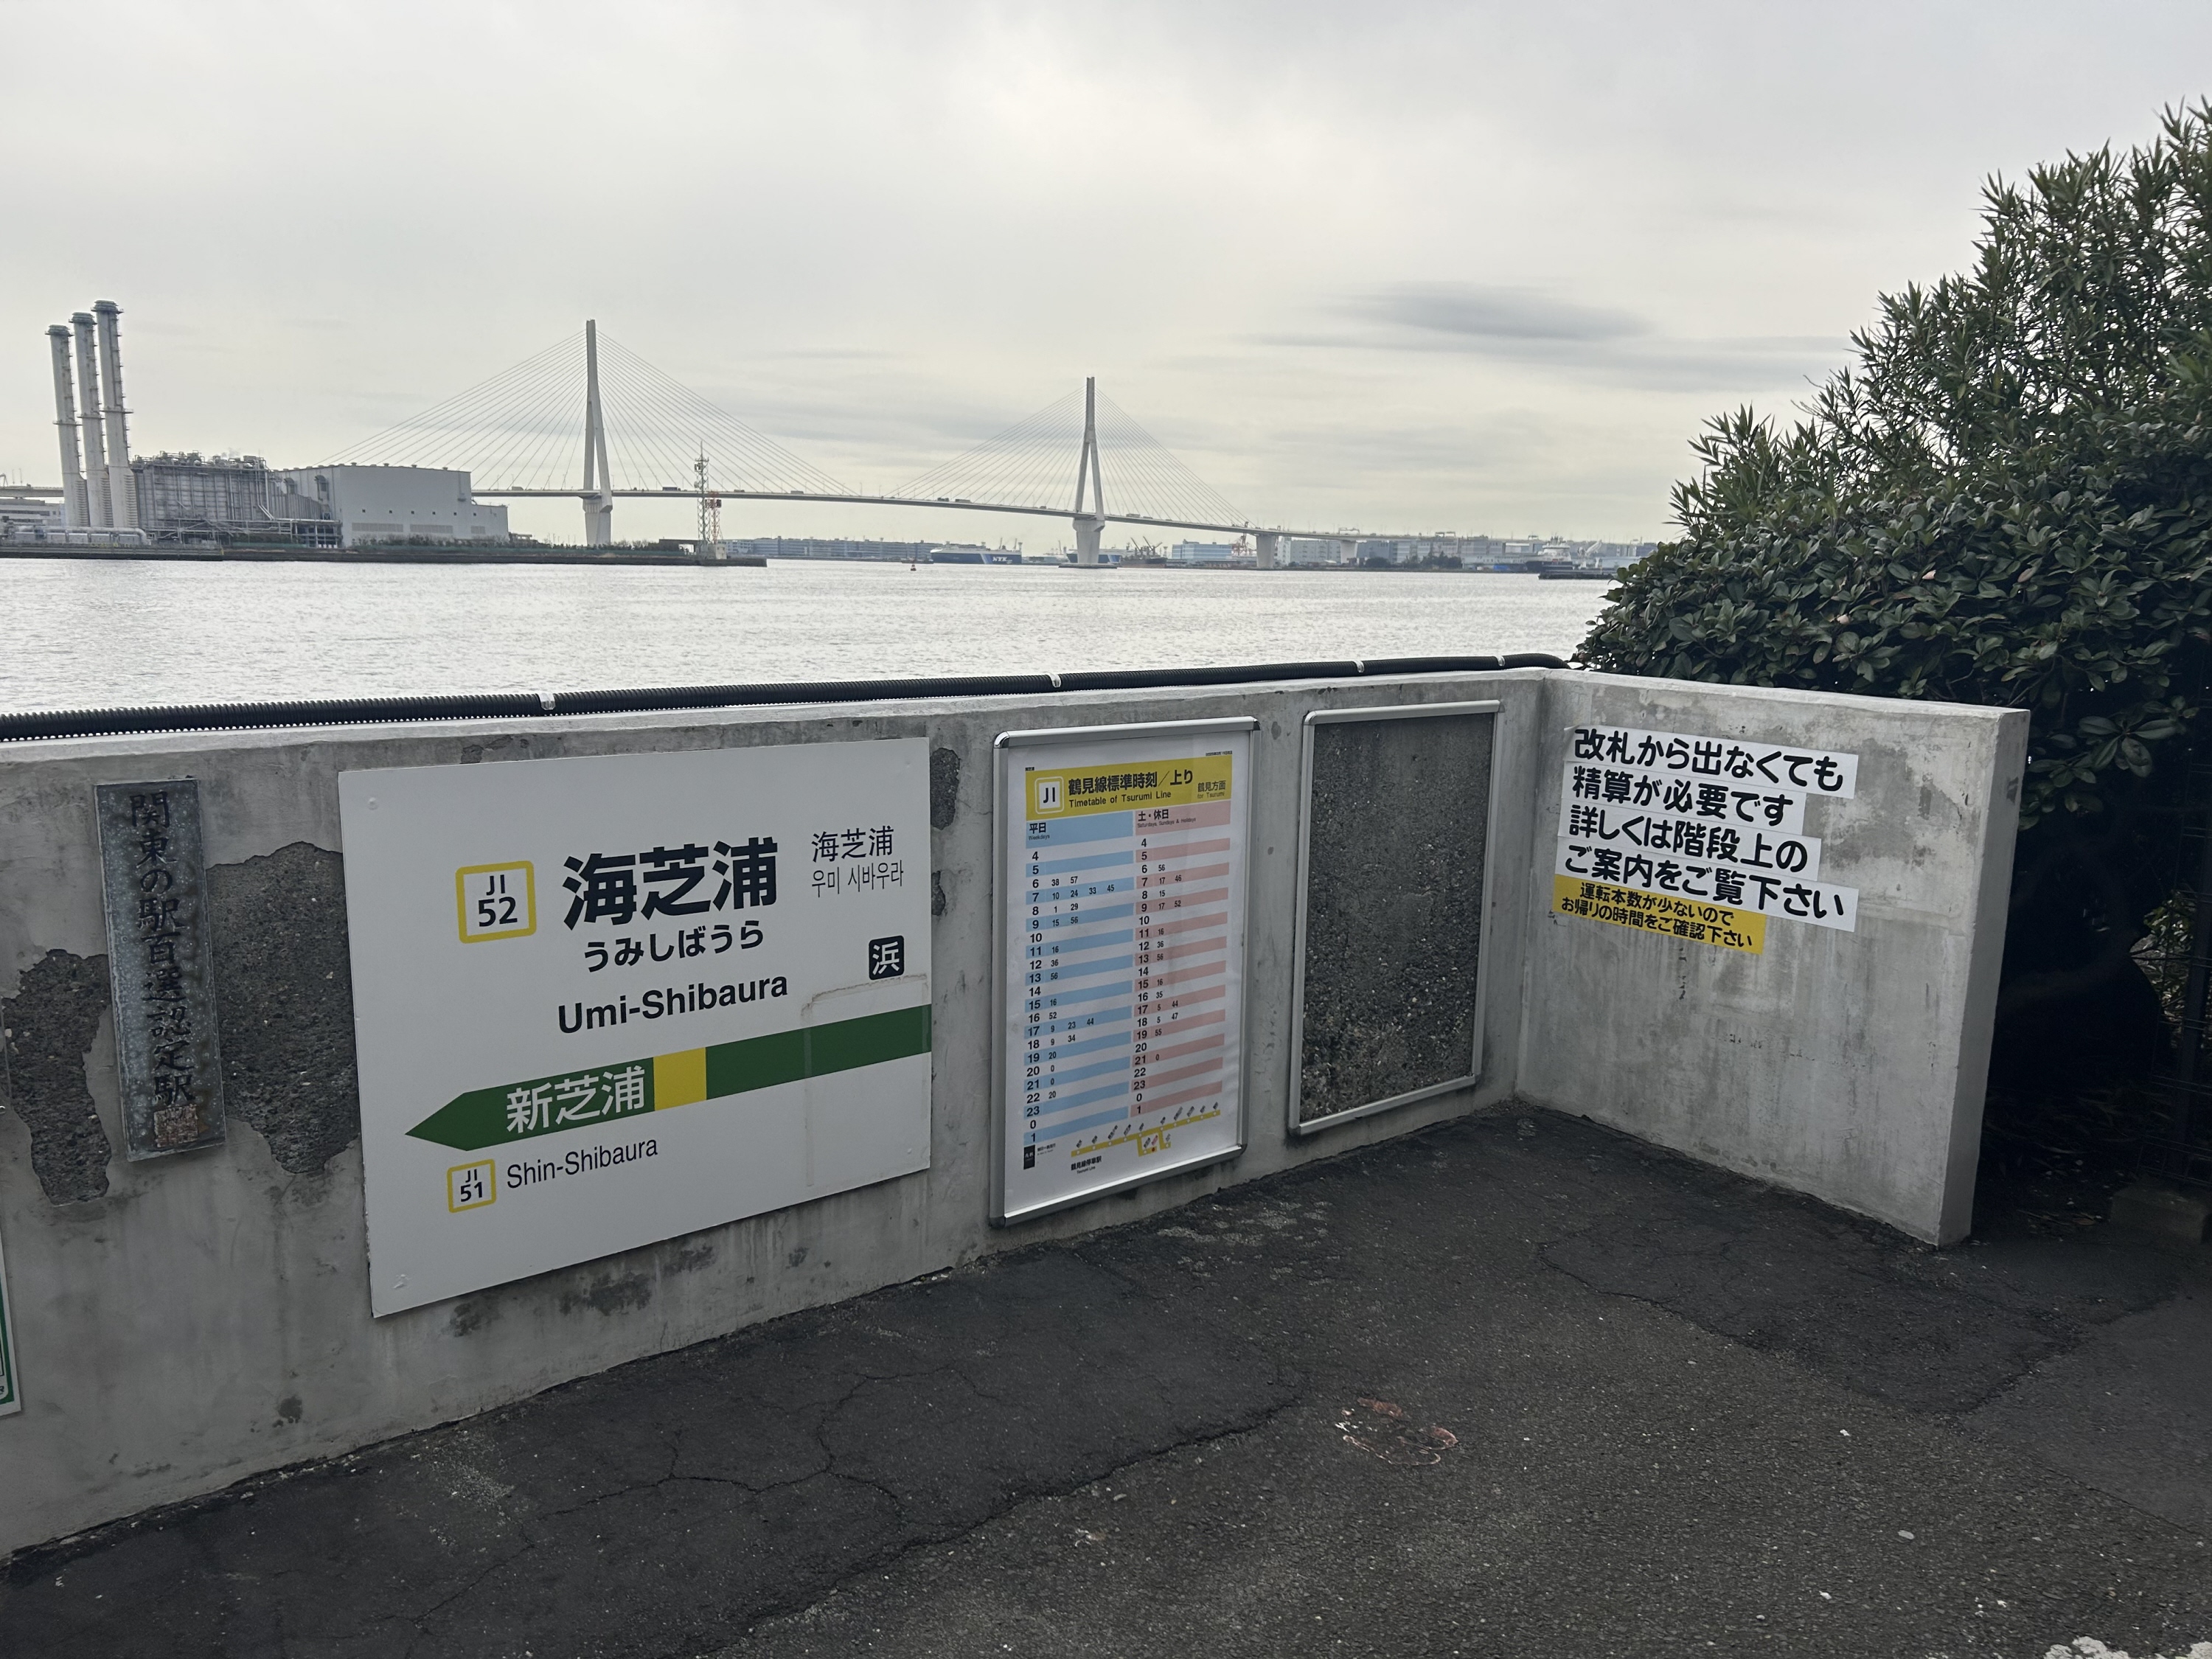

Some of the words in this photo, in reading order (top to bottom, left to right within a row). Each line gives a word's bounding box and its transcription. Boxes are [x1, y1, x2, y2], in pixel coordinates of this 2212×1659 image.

[1575, 728, 1843, 791] 改札から出なくても
[1197, 780, 1226, 793] 鶴見方面
[1043, 787, 1056, 804] JI
[1069, 796, 1107, 808] Timetable
[1110, 795, 1118, 804] of
[1121, 792, 1152, 802] Tsurumi
[1155, 790, 1172, 799] Line
[1572, 765, 1793, 826] 精算が必要です
[1138, 809, 1169, 821] 土・休日
[1029, 822, 1046, 834] 平日
[1141, 838, 1147, 847] 4
[1570, 804, 1807, 872] 詳しくは階段上の
[811, 826, 894, 864] 海芝浦
[1032, 852, 1039, 860] 4
[1141, 852, 1147, 860] 5
[1032, 865, 1039, 874] 5
[1141, 864, 1147, 874] 6
[563, 836, 778, 931] 海芝浦
[812, 867, 841, 898] 우미
[848, 860, 904, 892] 시바우라
[1032, 879, 1039, 888] 6
[1071, 876, 1078, 884] 57
[1141, 877, 1148, 886] 7
[1159, 877, 1166, 885] 17
[1565, 844, 1843, 919] ご案内をご覧下さい
[486, 875, 507, 896] JI
[1032, 892, 1039, 902] 7
[1107, 884, 1115, 892] 45
[1142, 891, 1148, 900] 8
[1141, 903, 1147, 912] 9
[1580, 883, 1734, 925] 運転本数が少ないので
[478, 898, 518, 927] 52
[1032, 906, 1039, 915] 8
[1032, 920, 1039, 929] 9
[1052, 919, 1060, 927] 15
[1139, 916, 1150, 925] 10
[1562, 897, 1752, 947] お帰りの時間をご確認下さい
[1030, 933, 1042, 943] 10
[1139, 928, 1149, 938] 11
[129, 790, 196, 1105] 関東の駅百選認定駅
[585, 920, 764, 973] うみしばうら
[1030, 946, 1042, 956] 11
[1138, 941, 1150, 951] 12
[872, 942, 900, 974] 浜
[1138, 954, 1149, 964] 13
[1030, 960, 1042, 970] 12
[1138, 967, 1149, 976] 14
[1029, 973, 1041, 983] 13
[1138, 979, 1149, 989] 15
[1157, 978, 1164, 987] 16
[1029, 987, 1041, 997] 14
[1138, 992, 1148, 1002] 16
[558, 975, 788, 1034] Umi-Shibaura
[1029, 1000, 1040, 1010] 15
[1050, 998, 1057, 1006] 16
[1138, 1004, 1148, 1015] 17
[1172, 1000, 1178, 1008] 44
[1029, 1013, 1040, 1023] 16
[1137, 1018, 1147, 1027] 18
[1028, 1026, 1040, 1037] 17
[1068, 1021, 1076, 1029] 23
[1087, 1018, 1094, 1026] 44
[1137, 1030, 1147, 1040] 19
[1155, 1029, 1162, 1037] 55
[1028, 1040, 1040, 1050] 18
[1068, 1034, 1076, 1043] 34
[1135, 1043, 1147, 1053] 20
[1028, 1053, 1040, 1063] 19
[1048, 1051, 1057, 1060] 20
[1135, 1055, 1146, 1065] 21
[1026, 1066, 1040, 1077] 20
[1134, 1067, 1146, 1078] 22
[1027, 1079, 1039, 1091] 21
[1133, 1080, 1146, 1091] 23
[506, 1066, 645, 1135] 新芝浦
[1026, 1093, 1040, 1104] 22
[1048, 1091, 1057, 1099] 20
[1136, 1093, 1142, 1102] 0
[1026, 1106, 1040, 1117] 23
[1137, 1105, 1141, 1114] 1
[1030, 1120, 1037, 1129] 0
[1031, 1133, 1035, 1142] 1
[507, 1137, 658, 1189] Shin-Shibaura
[465, 1169, 479, 1183] JI
[460, 1182, 484, 1203] 51
